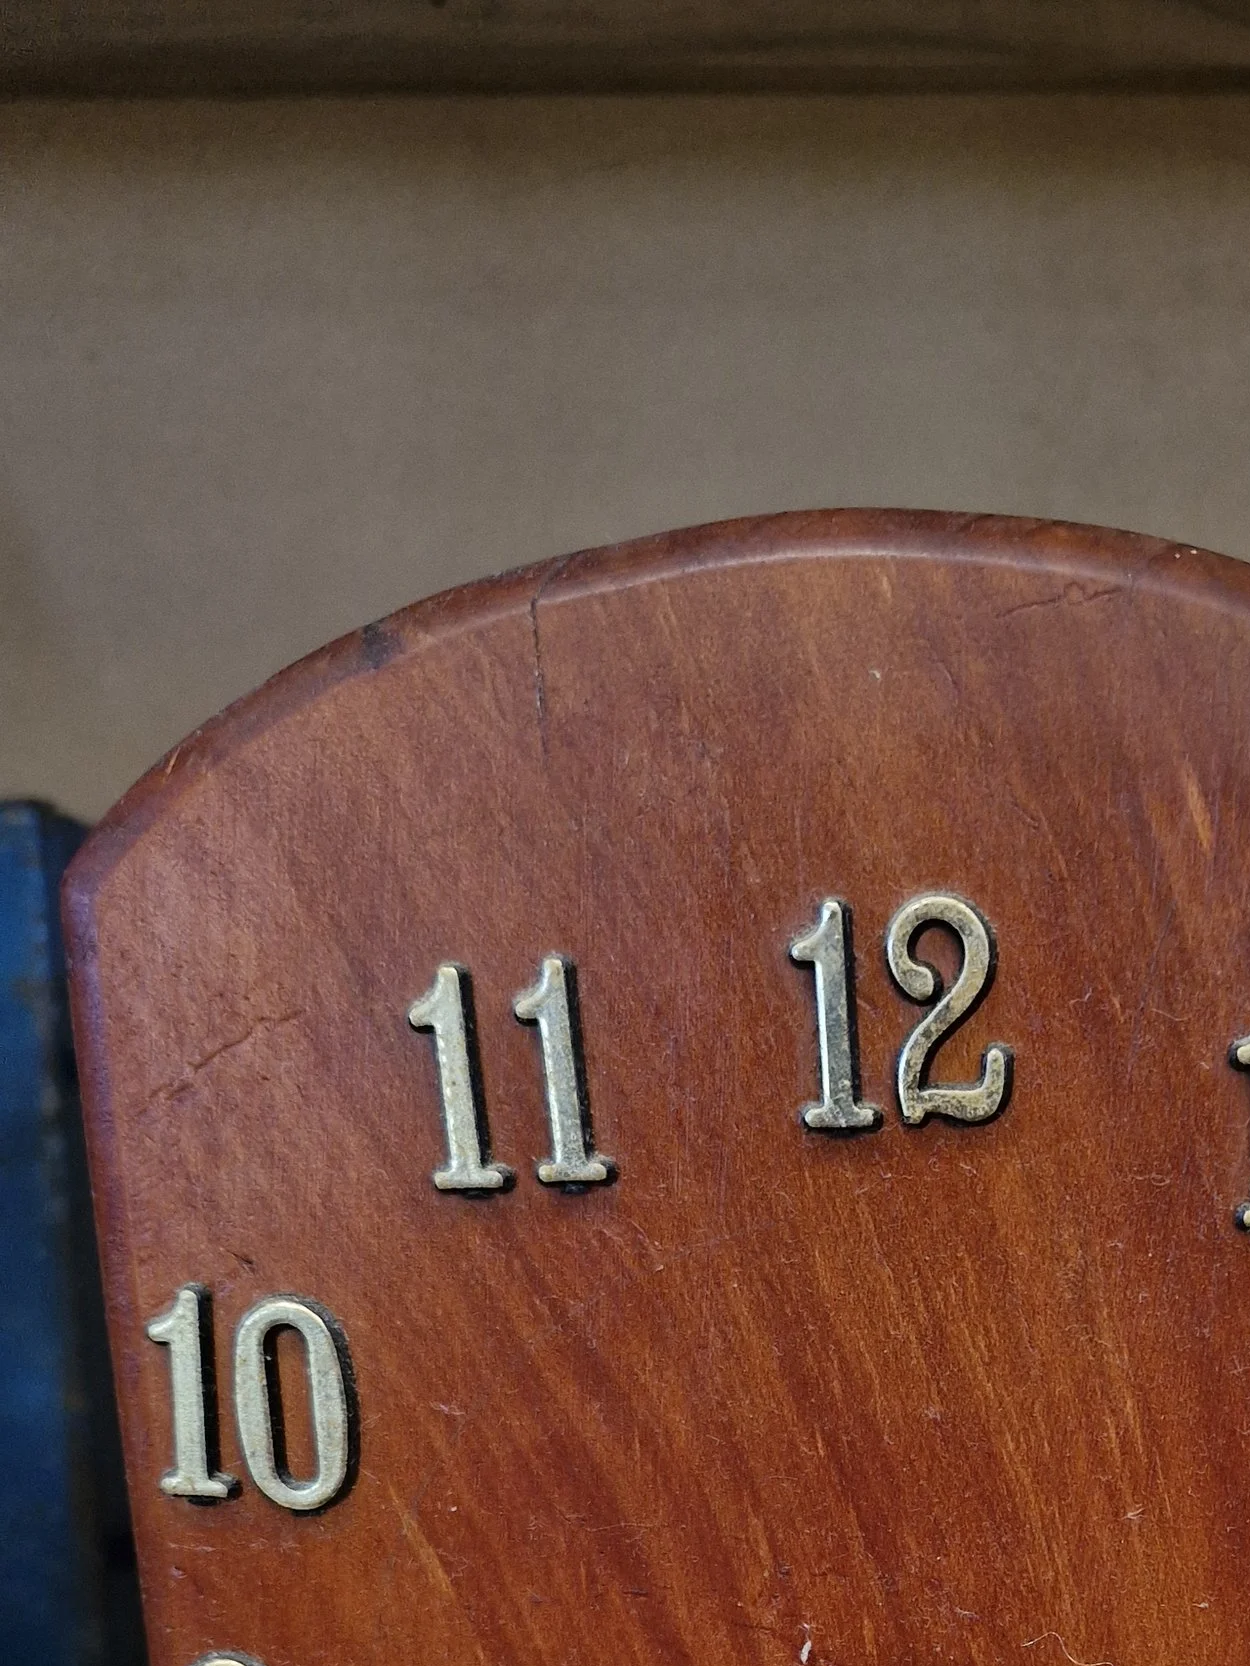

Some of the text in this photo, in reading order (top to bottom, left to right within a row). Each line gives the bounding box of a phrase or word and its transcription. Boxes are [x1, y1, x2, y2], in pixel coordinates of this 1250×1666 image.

[408, 956, 613, 1193] 11
[789, 895, 1011, 1131] 12
[148, 1285, 352, 1512] 10
